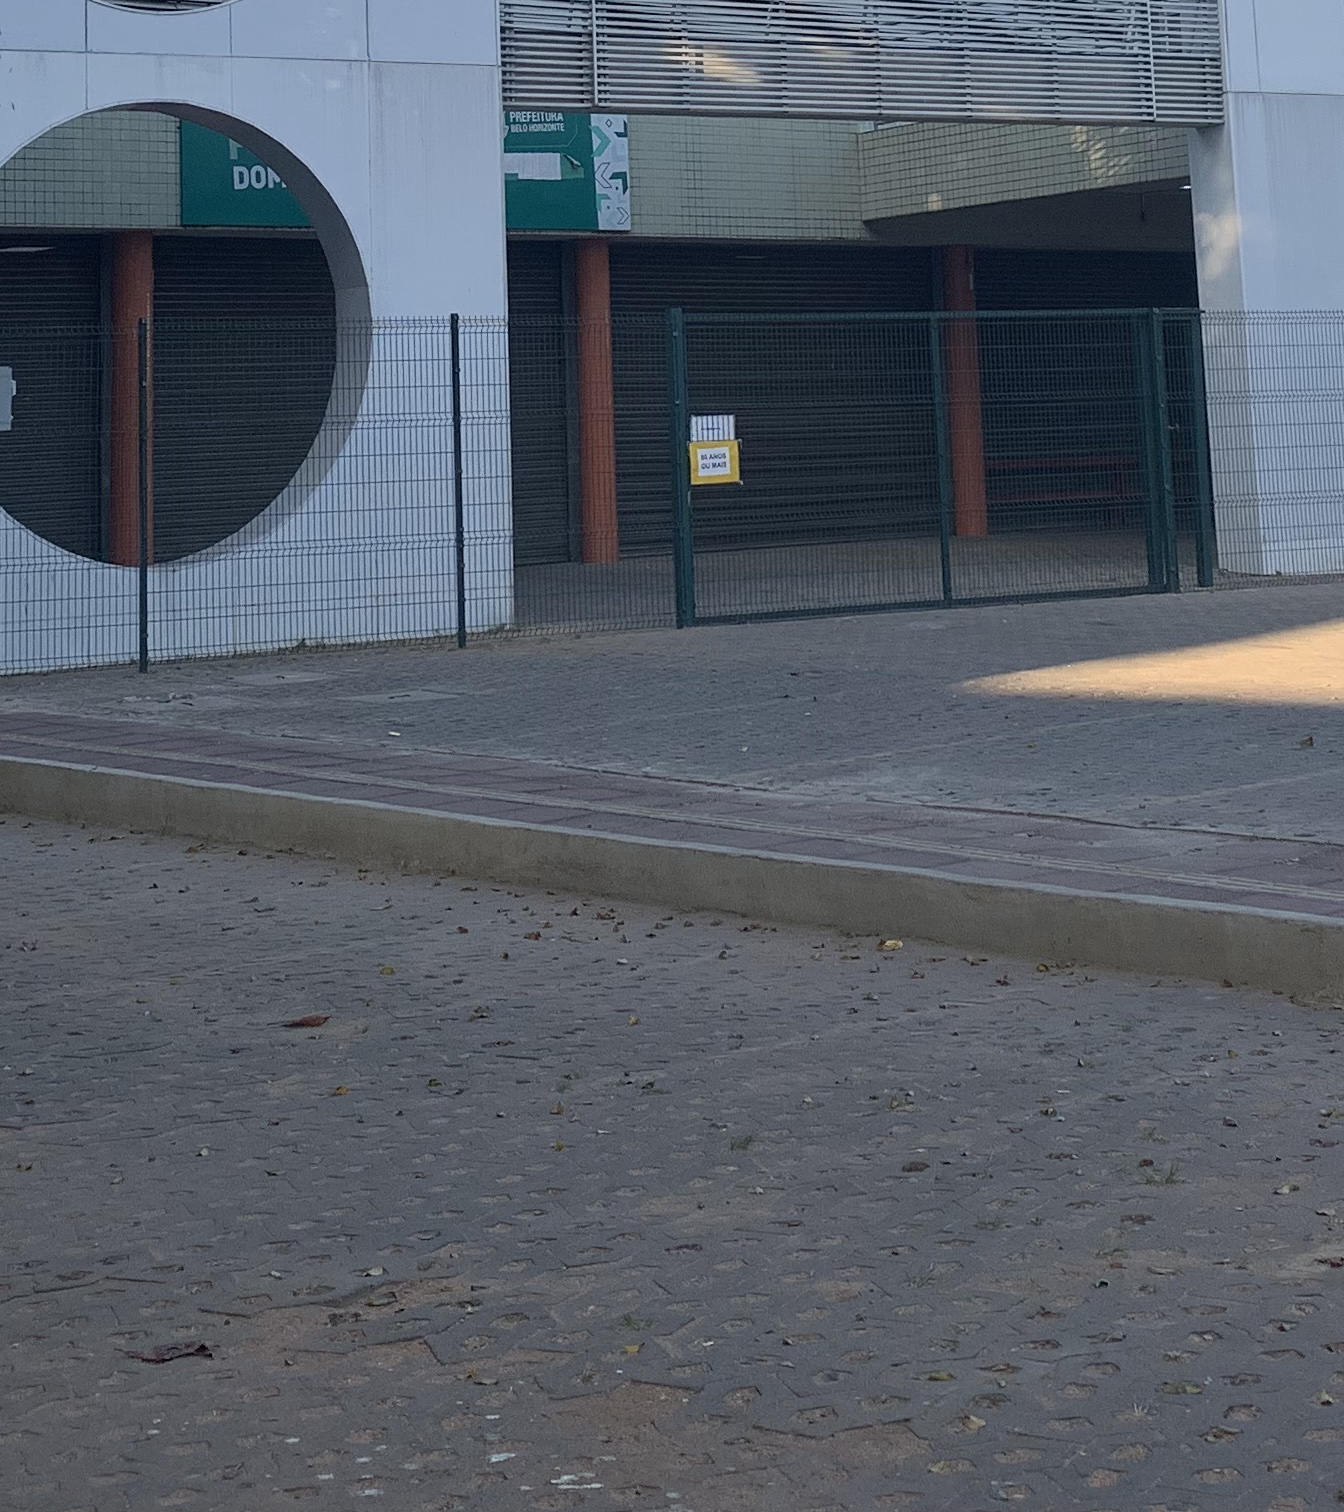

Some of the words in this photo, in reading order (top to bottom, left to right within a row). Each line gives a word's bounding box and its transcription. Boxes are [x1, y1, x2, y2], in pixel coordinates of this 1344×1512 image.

[509, 111, 564, 122] PREFEITURA
[510, 124, 528, 133] BELO
[529, 123, 565, 132] HORIZONTE
